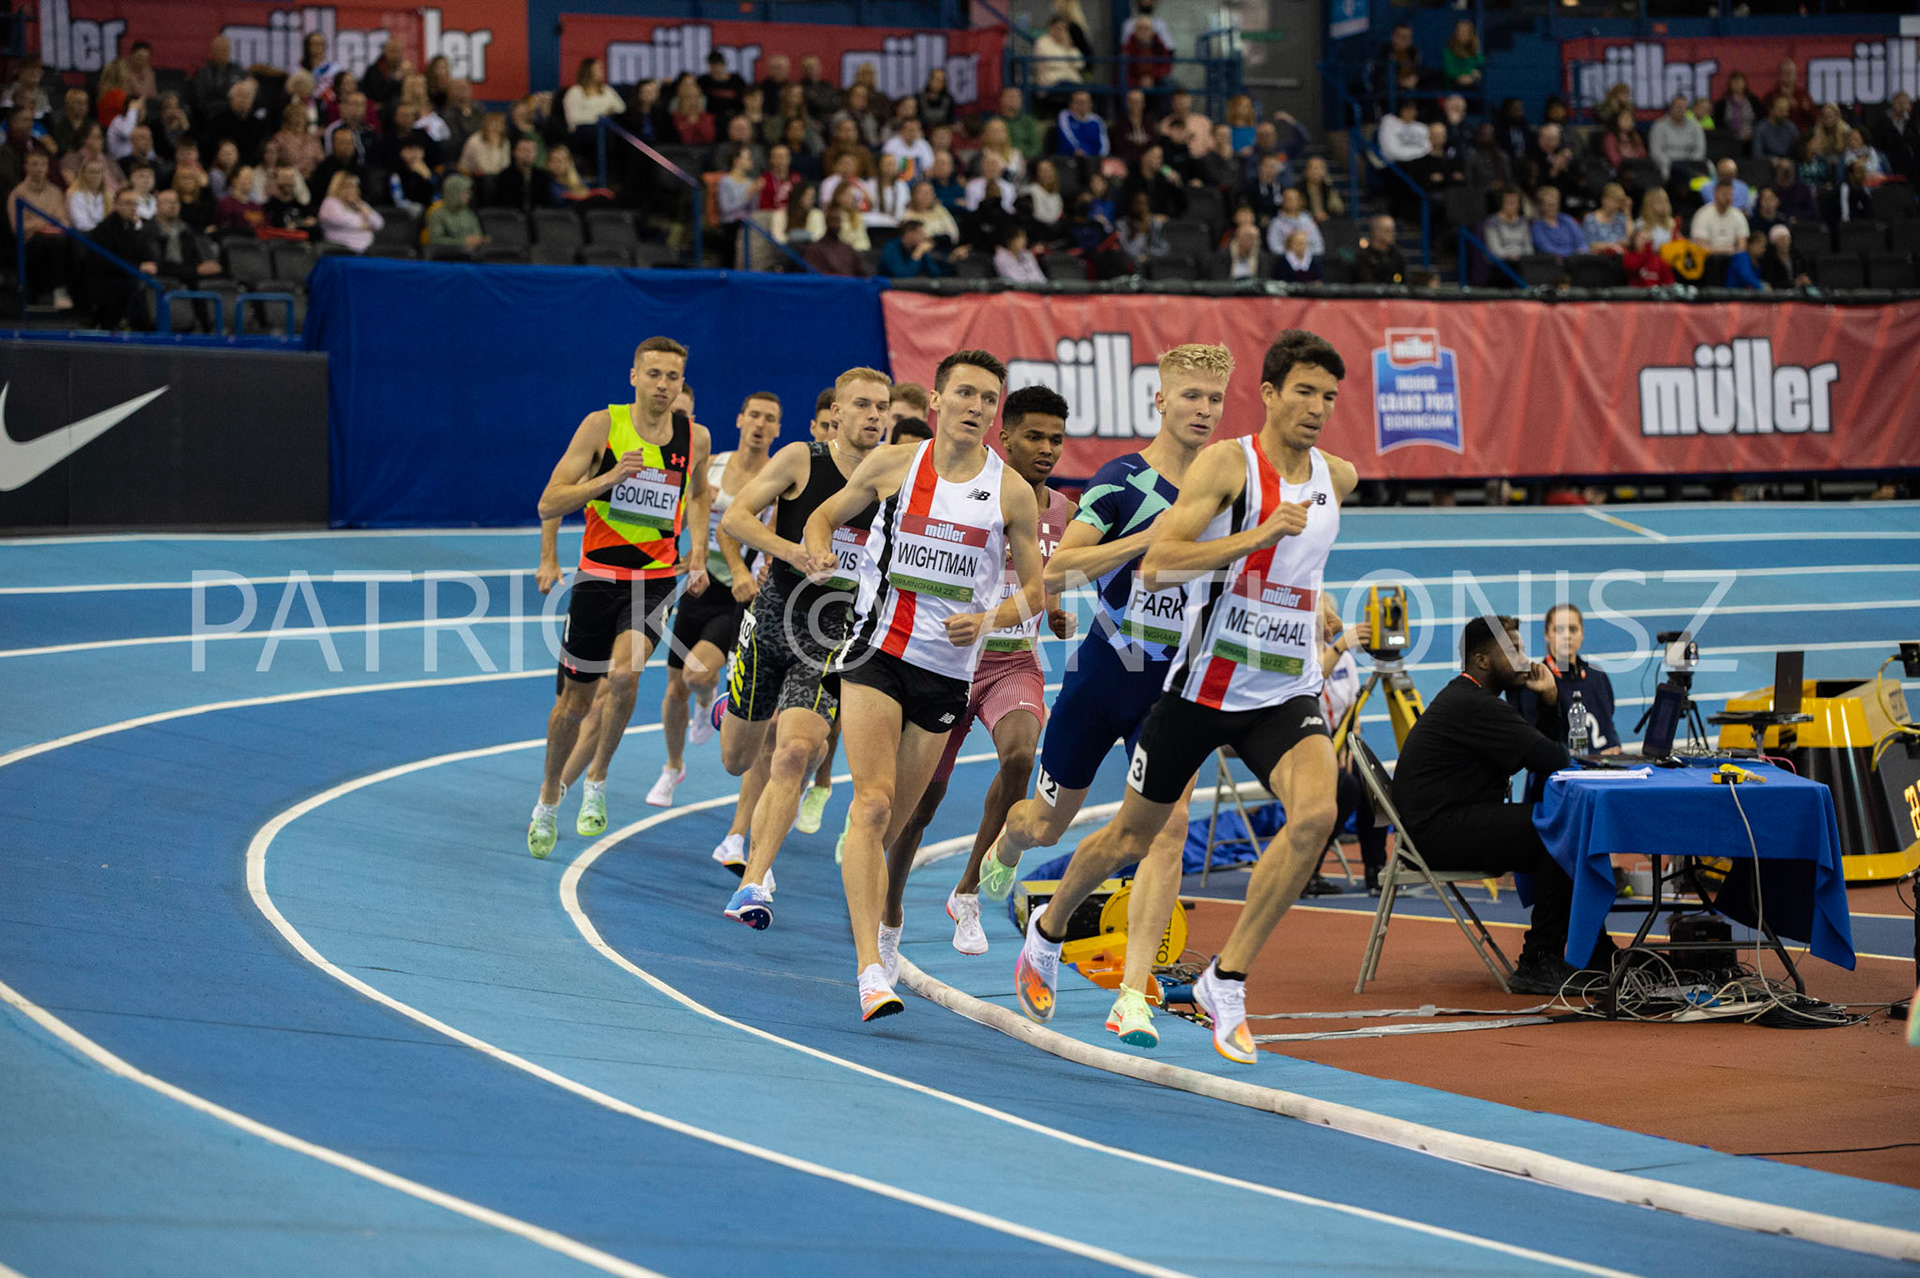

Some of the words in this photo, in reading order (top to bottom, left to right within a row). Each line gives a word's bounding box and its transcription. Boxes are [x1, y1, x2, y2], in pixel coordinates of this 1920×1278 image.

[1639, 337, 1840, 436] müller
[615, 484, 677, 511] GOURLEY
[924, 523, 966, 543] müller
[898, 542, 978, 578] WIGHTMAN
[891, 577, 942, 594] BIRMINGHAM
[943, 588, 954, 597] 22
[1262, 586, 1302, 608] müller
[1225, 606, 1306, 646] MECHAAL
[1133, 758, 1143, 782] 3
[1040, 769, 1057, 799] 12
